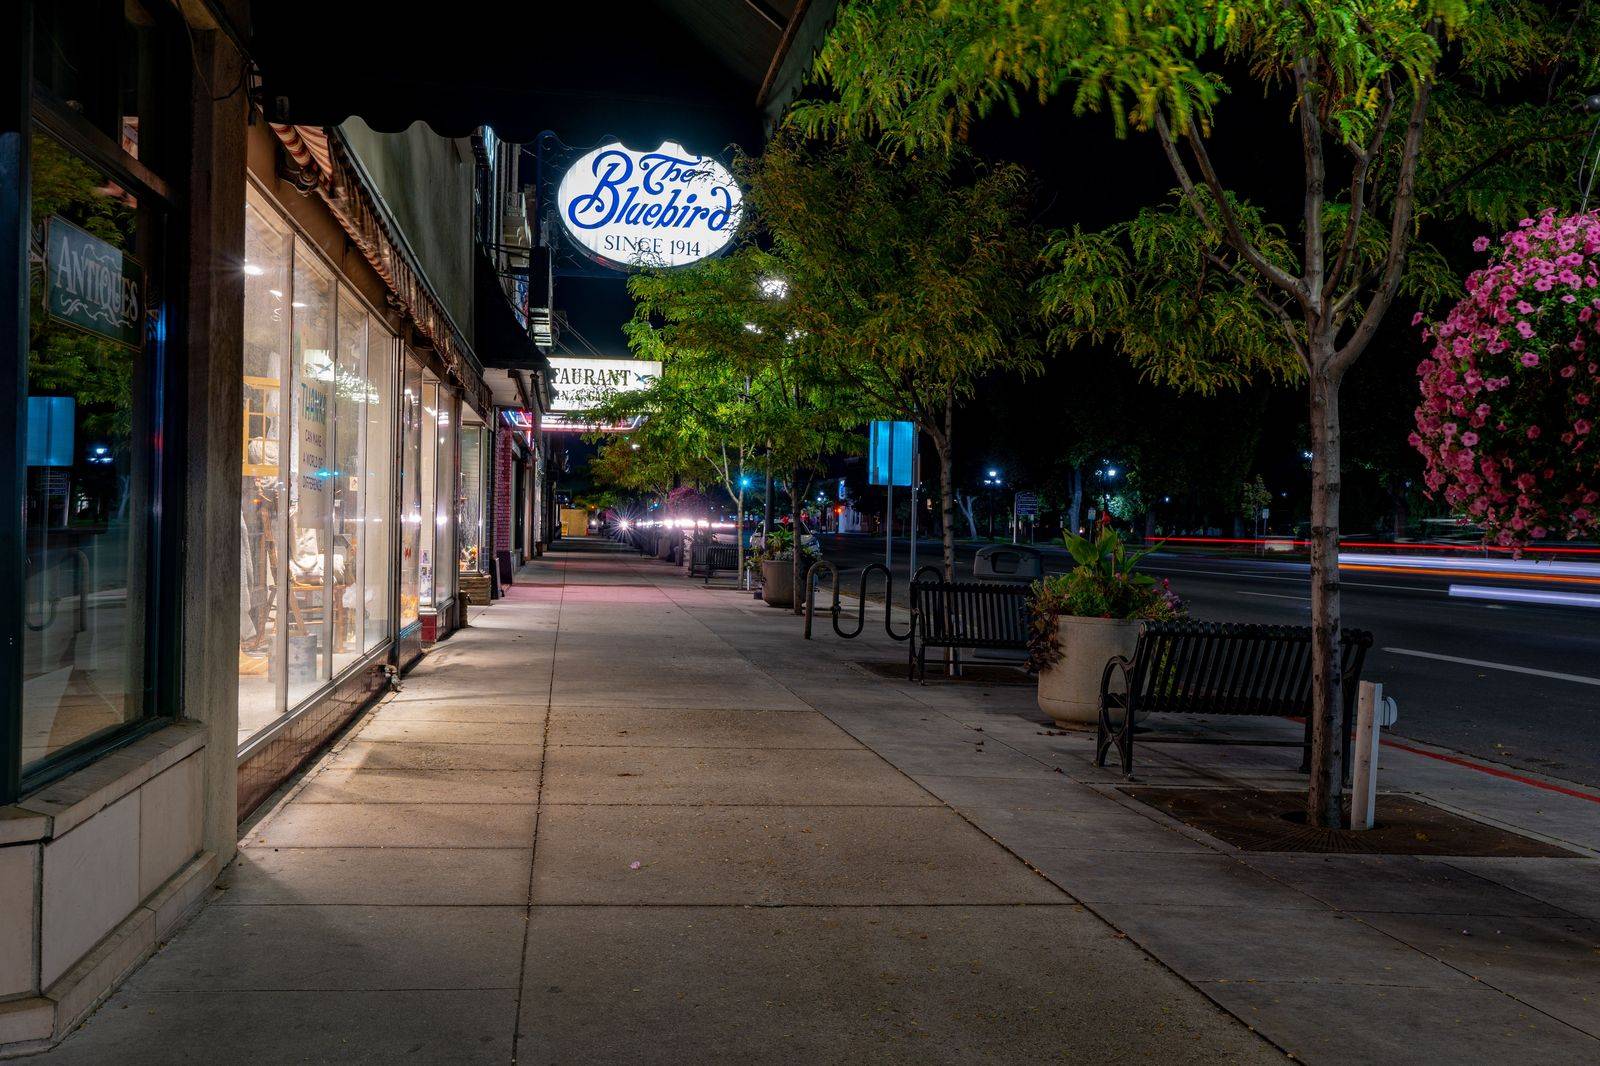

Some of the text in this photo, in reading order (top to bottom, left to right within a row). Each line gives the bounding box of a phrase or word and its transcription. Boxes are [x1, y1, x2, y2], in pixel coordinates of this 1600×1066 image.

[568, 150, 732, 231] Bluebird
[639, 153, 702, 195] The
[604, 234, 700, 256] SINCE 1914
[55, 236, 138, 326] ANTIQUES
